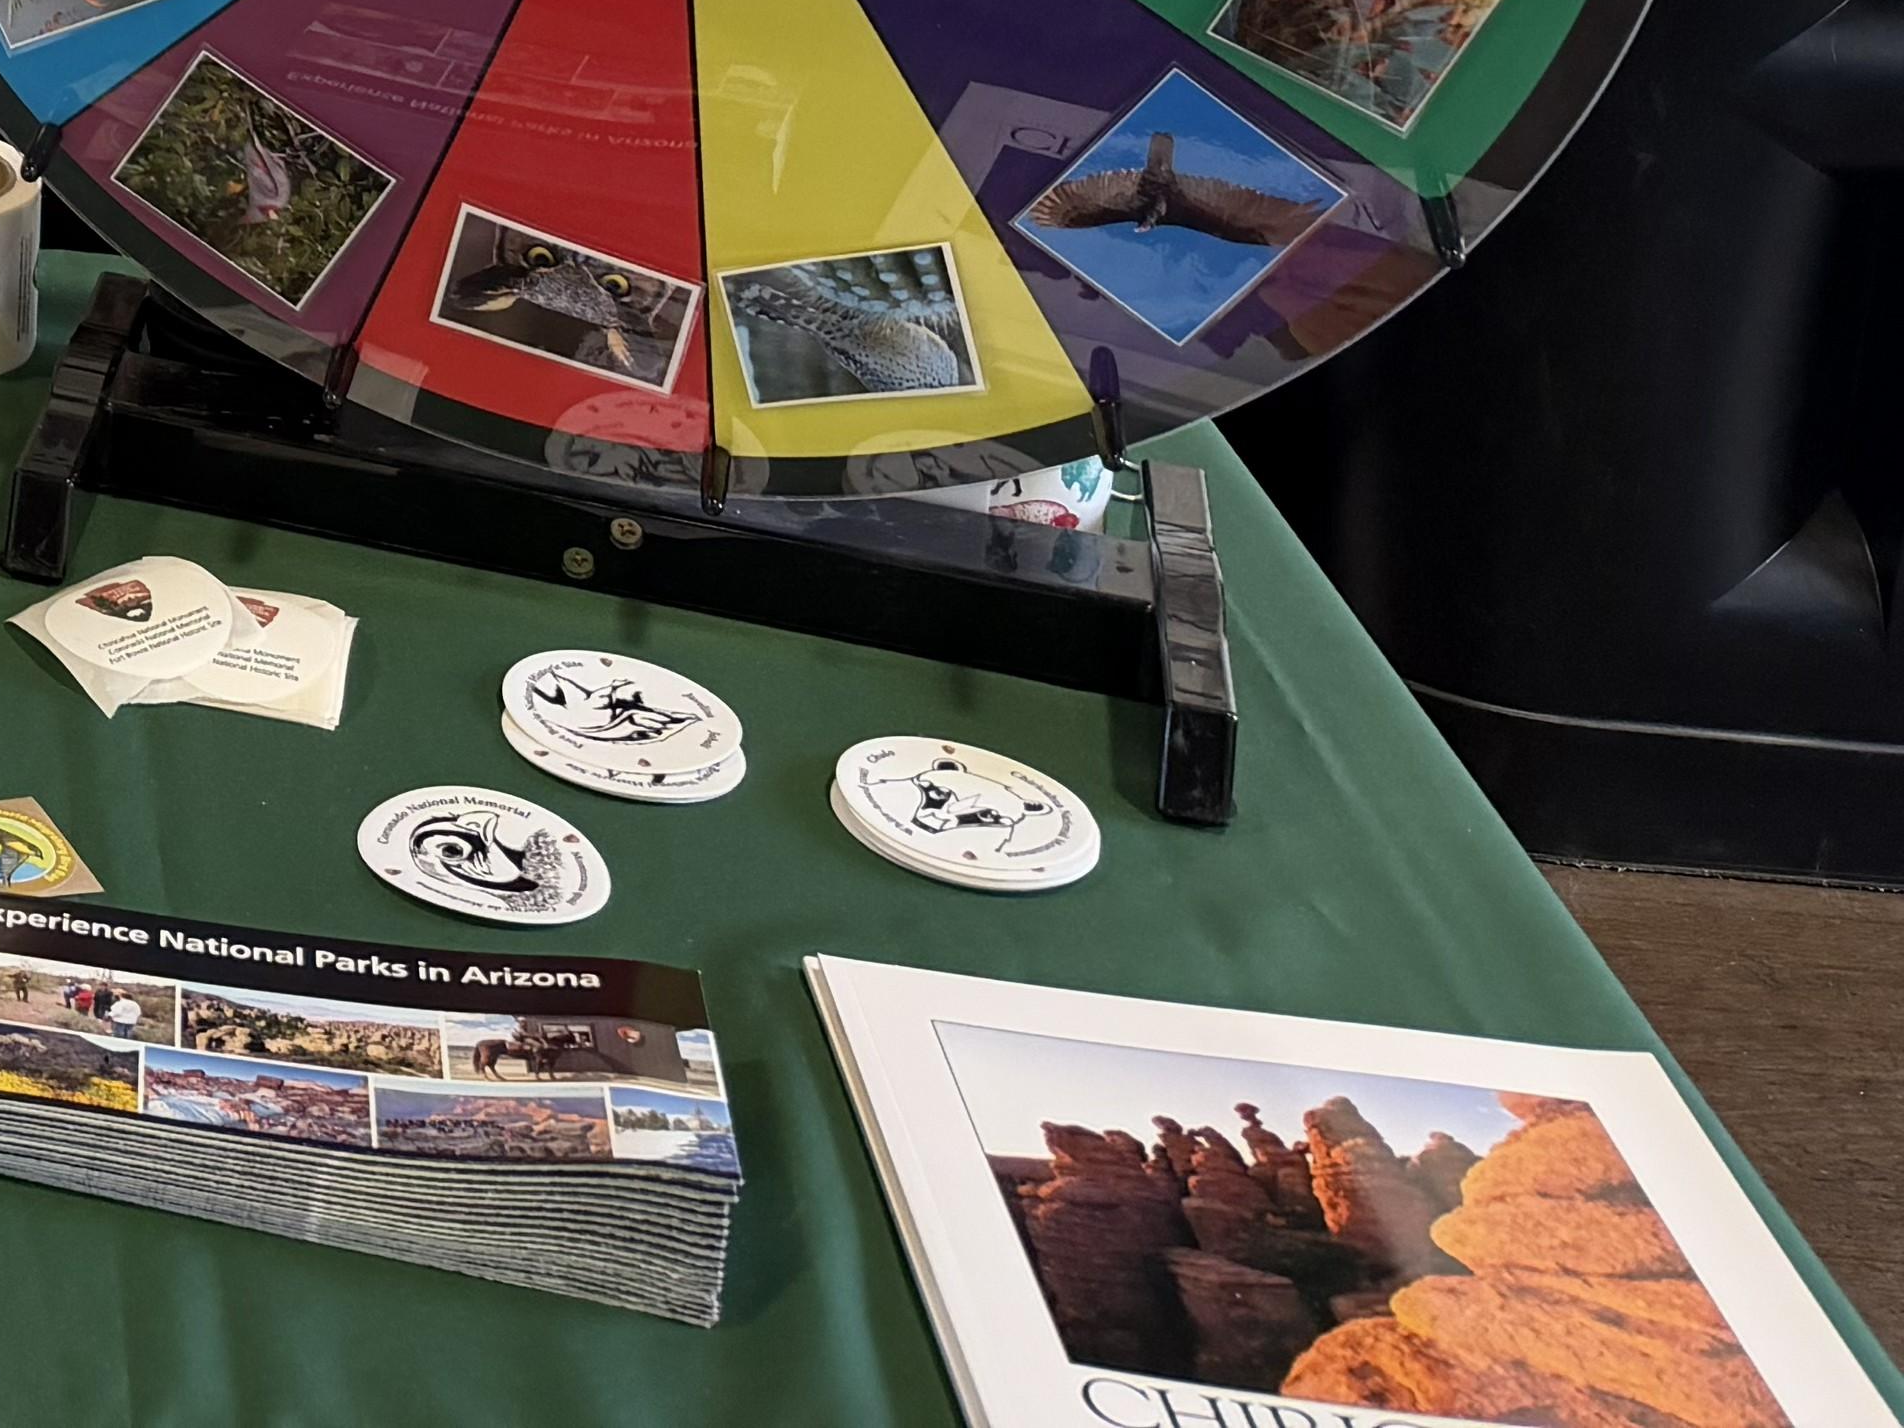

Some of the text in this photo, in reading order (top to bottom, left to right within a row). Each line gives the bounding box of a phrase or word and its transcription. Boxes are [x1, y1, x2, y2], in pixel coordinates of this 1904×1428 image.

[211, 657, 248, 672] National
[376, 795, 532, 845] Coronado National Memorial
[158, 929, 305, 970] National
[314, 948, 409, 981] Parks
[417, 959, 450, 984] in
[461, 962, 603, 991] Arizona
